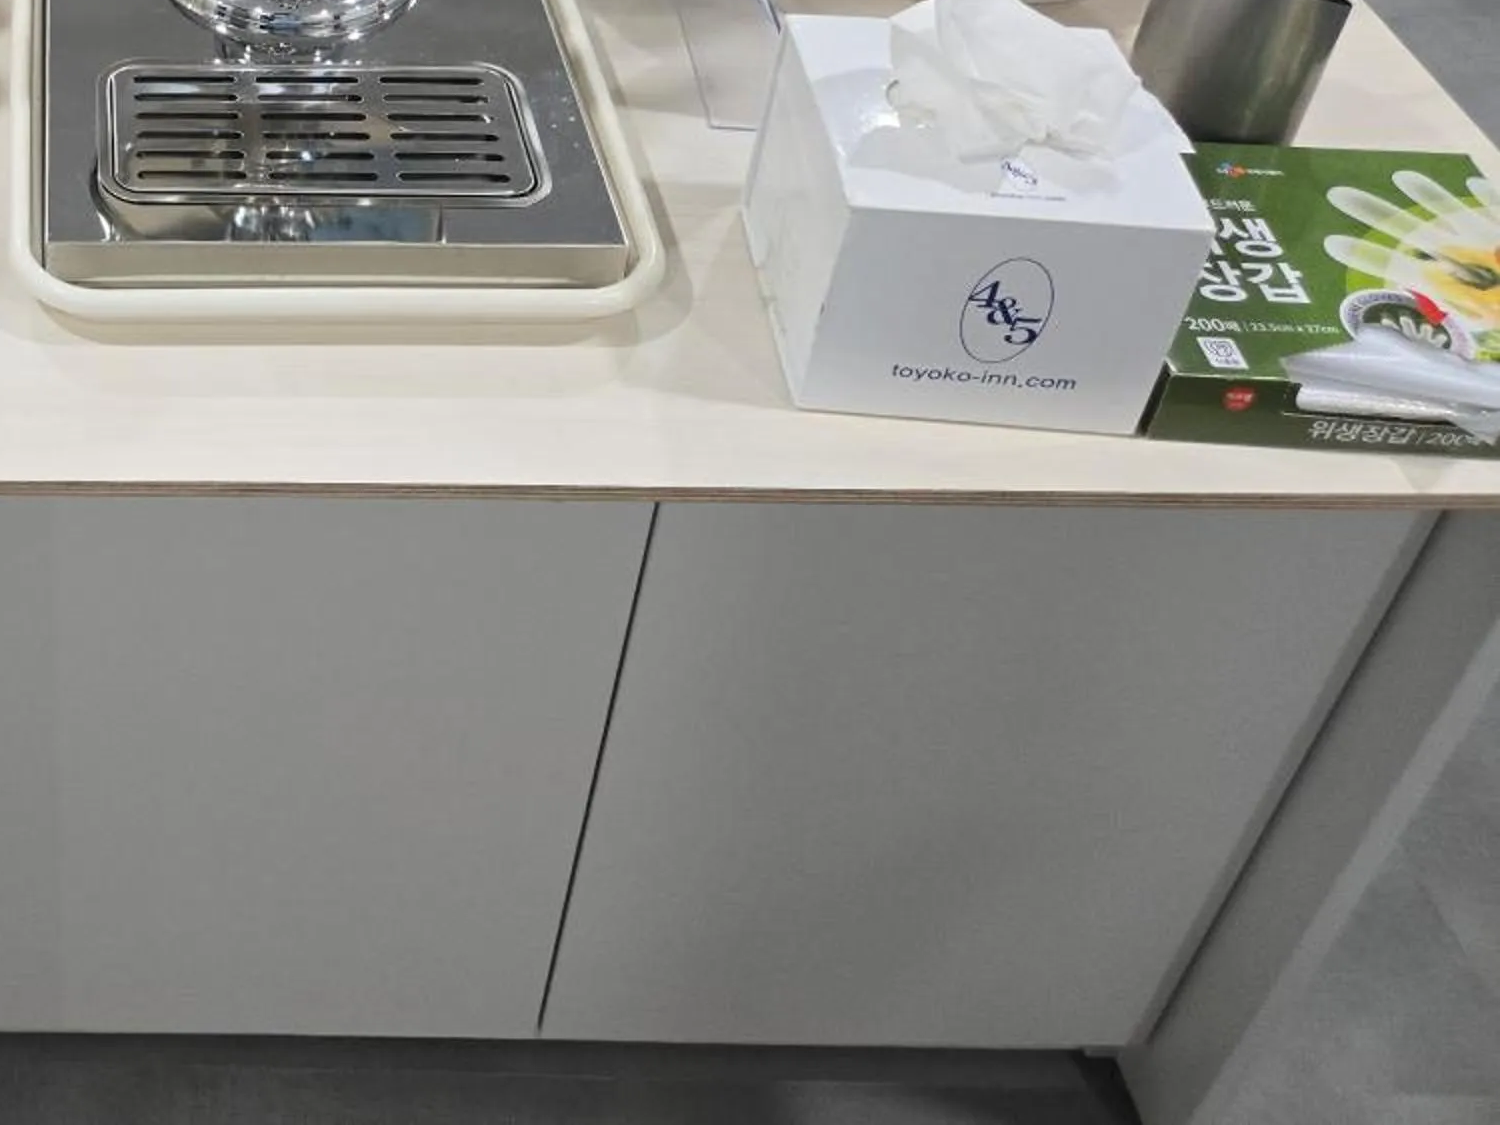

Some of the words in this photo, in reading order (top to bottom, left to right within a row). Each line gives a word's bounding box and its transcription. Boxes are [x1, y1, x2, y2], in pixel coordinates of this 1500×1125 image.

[1209, 217, 1284, 258] 생
[1200, 260, 1312, 304] 장갑
[967, 280, 1043, 345] 4&5
[892, 364, 1077, 390] toyoko-inn.com
[1308, 420, 1418, 445] 위생장갑
